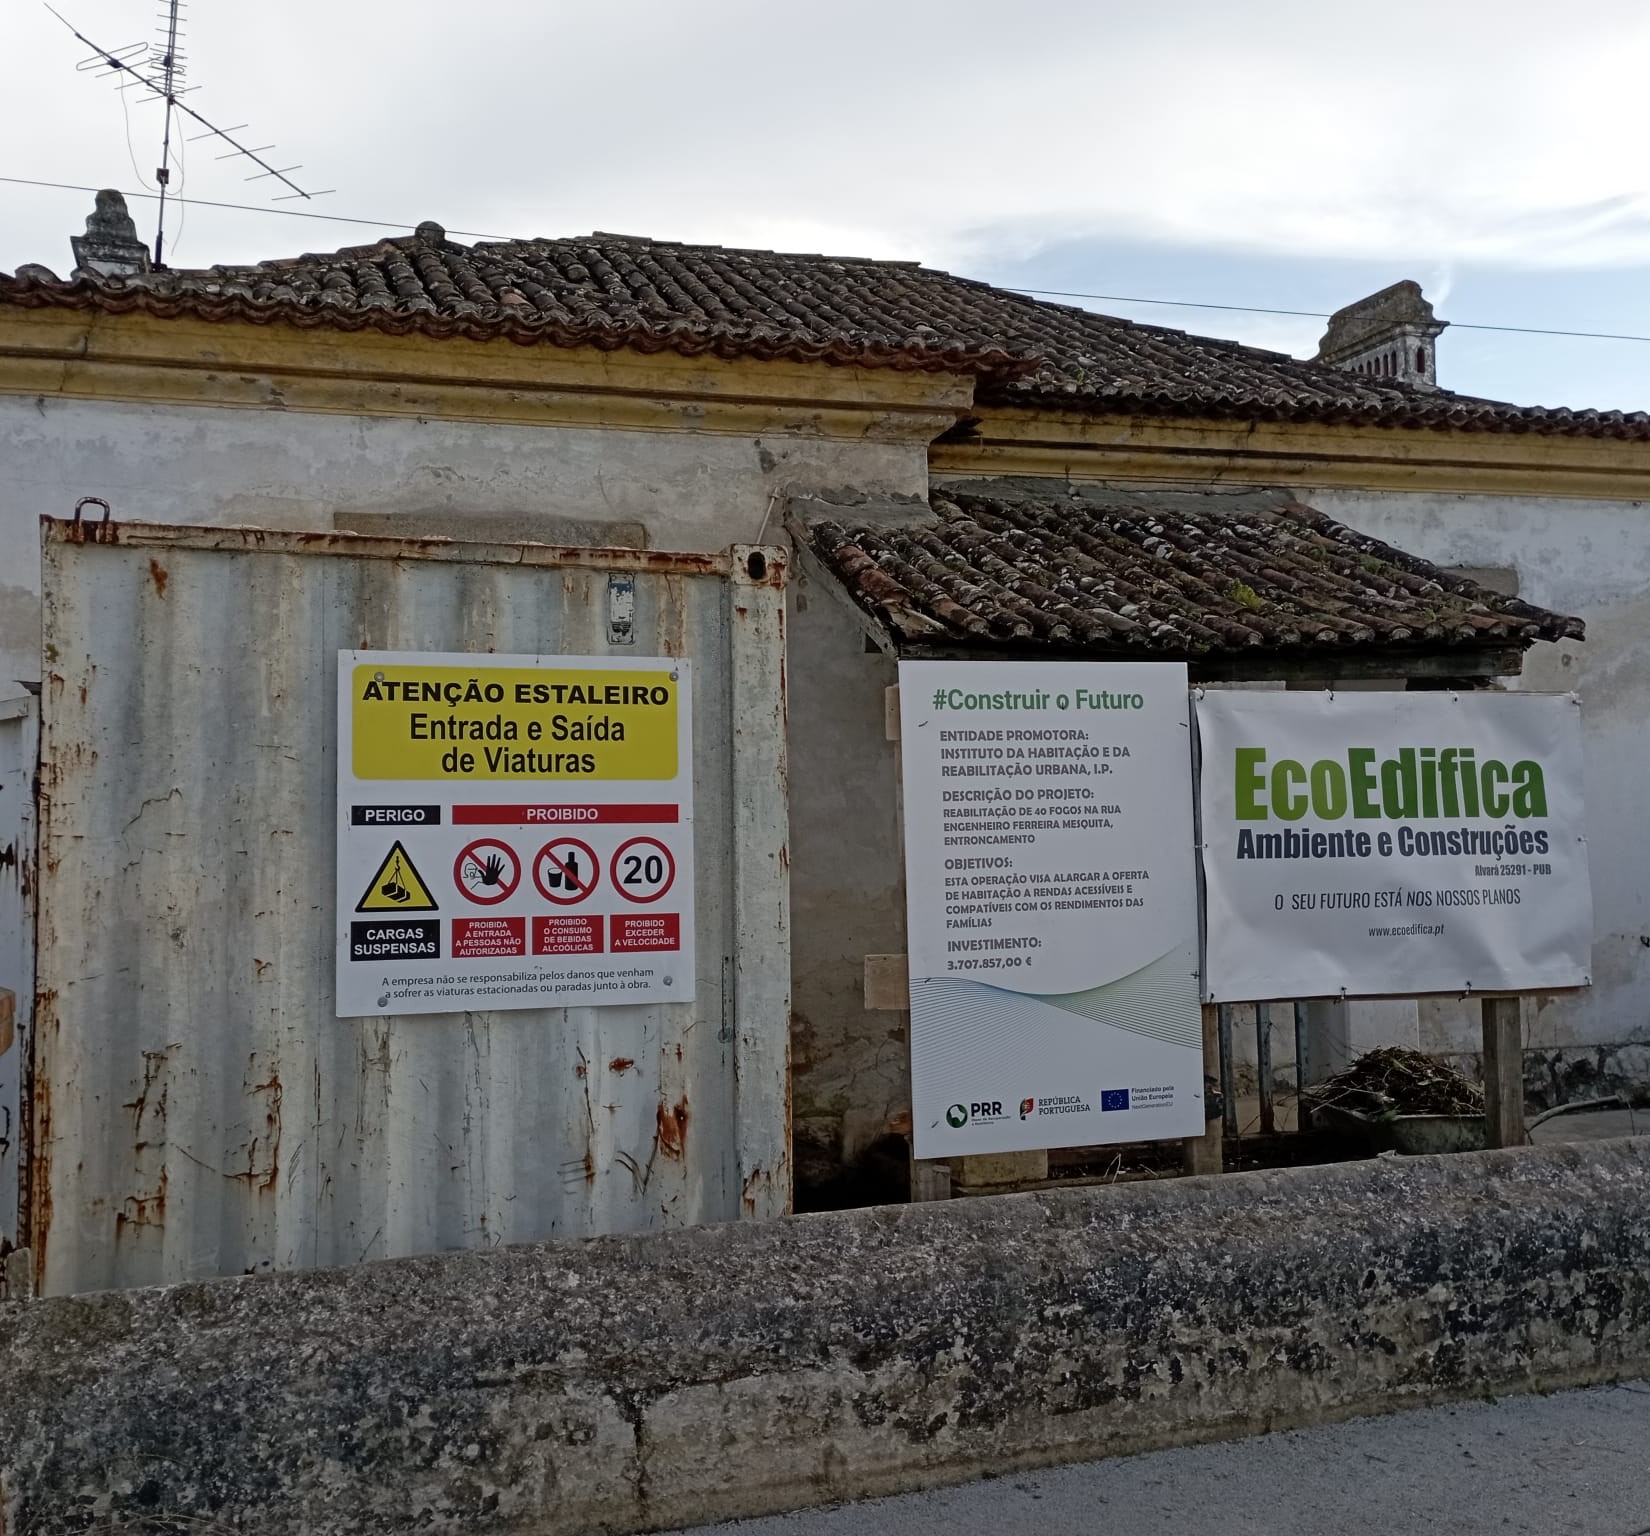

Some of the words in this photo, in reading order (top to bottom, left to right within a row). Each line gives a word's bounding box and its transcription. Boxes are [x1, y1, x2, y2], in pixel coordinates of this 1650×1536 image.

[363, 680, 504, 706] ATENÇÃO
[515, 685, 669, 705] ESTALEIRO
[933, 689, 1049, 710] #Construir
[1056, 694, 1069, 710] o
[1076, 690, 1144, 710] Futuro
[411, 714, 518, 740] Entrada
[527, 721, 542, 740] e
[552, 715, 625, 741] Saída
[941, 731, 1004, 741] ENTIDADE
[1006, 730, 1089, 741] PROMOTORA:
[442, 748, 474, 772] de
[484, 747, 595, 773] Viaturas
[941, 748, 1004, 759] INSTITUTO
[1006, 748, 1025, 758] DA
[1028, 746, 1099, 760] HABITAÇÃO
[1103, 747, 1110, 757] E
[1113, 747, 1130, 757] DA
[942, 763, 1032, 778] REABILITAÇÃO
[1035, 765, 1091, 777] URBANA,
[1094, 765, 1112, 775] I.P.
[1235, 748, 1548, 820] EcoEdifica
[943, 788, 1012, 803] DESCRIÇÃO
[1016, 790, 1035, 801] DO
[1038, 789, 1094, 801] PROJETO:
[365, 810, 425, 822] PERIGO
[527, 808, 598, 820] PROIBIDO
[943, 806, 1016, 818] REABILITAÇÃO
[1019, 807, 1032, 816] DE
[1035, 807, 1047, 816] 40
[1049, 806, 1081, 815] FOGOS
[1084, 806, 1098, 815] NA
[1101, 805, 1121, 814] RUA
[944, 821, 1010, 831] ENGENHEIRO
[1013, 820, 1060, 830] FERREIRA
[1062, 819, 1113, 830] MESQUITA,
[944, 835, 1035, 845] ENTRONCAMENTO
[1236, 828, 1370, 859] Ambiente
[1378, 834, 1392, 856] e
[1398, 825, 1549, 860] Construções
[623, 856, 663, 884] 20
[945, 858, 1012, 871] OBJETIVOS:
[1475, 864, 1498, 876] Alvará
[1500, 864, 1526, 876] 25291
[1533, 864, 1551, 875] PUB
[945, 877, 968, 886] ESTA
[971, 872, 1027, 885] OPERAÇÃO
[1030, 874, 1051, 883] VISA
[1053, 872, 1101, 882] ALARGAR
[1103, 872, 1110, 881] A
[1112, 871, 1149, 881] OFERTA
[946, 891, 959, 900] DE
[962, 887, 1021, 899] HABITAÇÃO
[1024, 889, 1031, 897] A
[1033, 887, 1072, 897] RENDAS
[1074, 883, 1124, 895] ACESSÍVEIS
[1127, 885, 1132, 893] E
[1275, 894, 1283, 910] O
[1292, 894, 1316, 909] SEU
[1320, 892, 1370, 909] FUTURO
[1375, 887, 1402, 907] ESTÁ
[1406, 891, 1433, 906] NOS
[1437, 890, 1480, 906] NOSSOS
[1483, 889, 1520, 905] PLANOS
[946, 901, 1012, 914] COMPATÍVEIS
[1015, 902, 1037, 911] COM
[1040, 901, 1052, 910] OS
[1054, 899, 1123, 910] RENDIMENTOS
[1126, 898, 1144, 907] DAS
[549, 918, 587, 926] PROIBIDO
[946, 916, 992, 928] FAMÍLIAS
[366, 929, 424, 940] CARGAS
[1368, 924, 1444, 938] www.ecoedifica.pt
[464, 938, 502, 946] PESSOAS
[503, 937, 521, 945] NÃO
[542, 944, 593, 952] ALCOÓLICAS
[620, 937, 675, 945] VELOCIDADE
[948, 938, 1042, 952] INVESTIMENTO:
[354, 943, 435, 955] SUSPENSAS
[947, 957, 1022, 970] 3.707.857,00
[1026, 956, 1032, 966] €
[382, 977, 389, 986] A
[391, 976, 434, 988] empresa
[436, 975, 455, 984] não
[457, 976, 467, 984] se
[470, 972, 537, 984] responsabiliza
[540, 971, 564, 982] pelos
[566, 970, 594, 980] danos
[597, 971, 614, 981] que
[616, 968, 654, 978] venham
[393, 988, 422, 998] sofrer
[437, 986, 474, 997] viaturas
[477, 984, 538, 995] estacionadas
[554, 983, 590, 995] paradas
[592, 982, 616, 993] junto
[619, 981, 625, 990] à
[628, 981, 651, 990] obra.
[1039, 1096, 1081, 1106] REPÚBLICA
[971, 1102, 1002, 1116] PRR
[1039, 1104, 1090, 1115] PORTUGUESA
